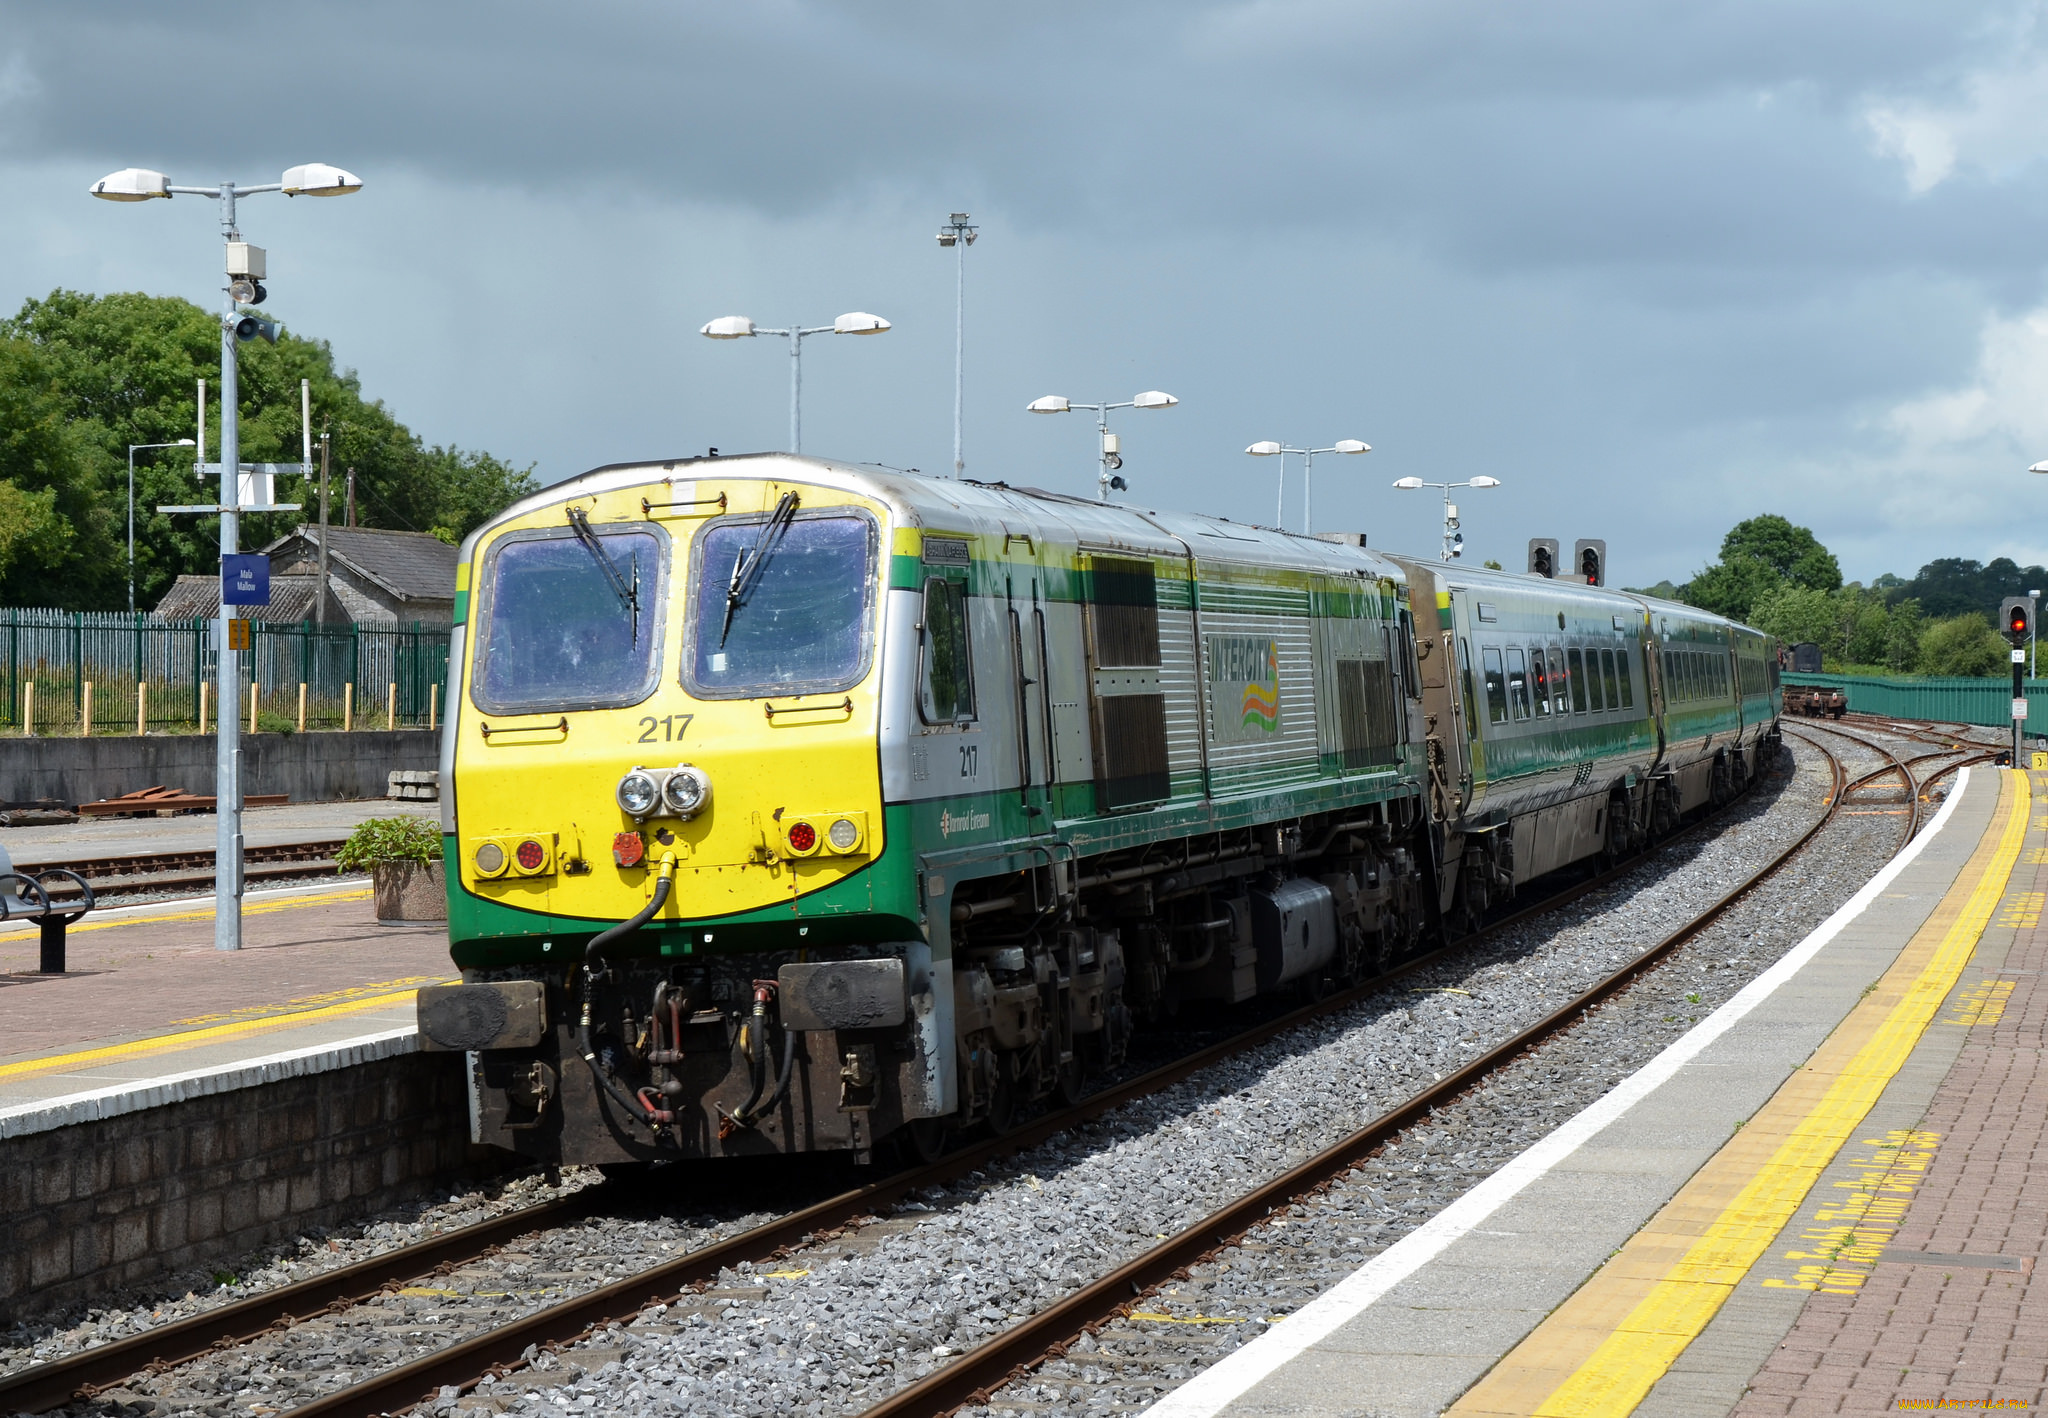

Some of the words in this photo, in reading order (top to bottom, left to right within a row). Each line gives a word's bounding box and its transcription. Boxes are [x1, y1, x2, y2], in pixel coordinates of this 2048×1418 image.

[237, 581, 256, 591] Mallow
[1211, 638, 1271, 681] INTERCITY
[638, 714, 694, 743] 217
[960, 746, 978, 777] 217
